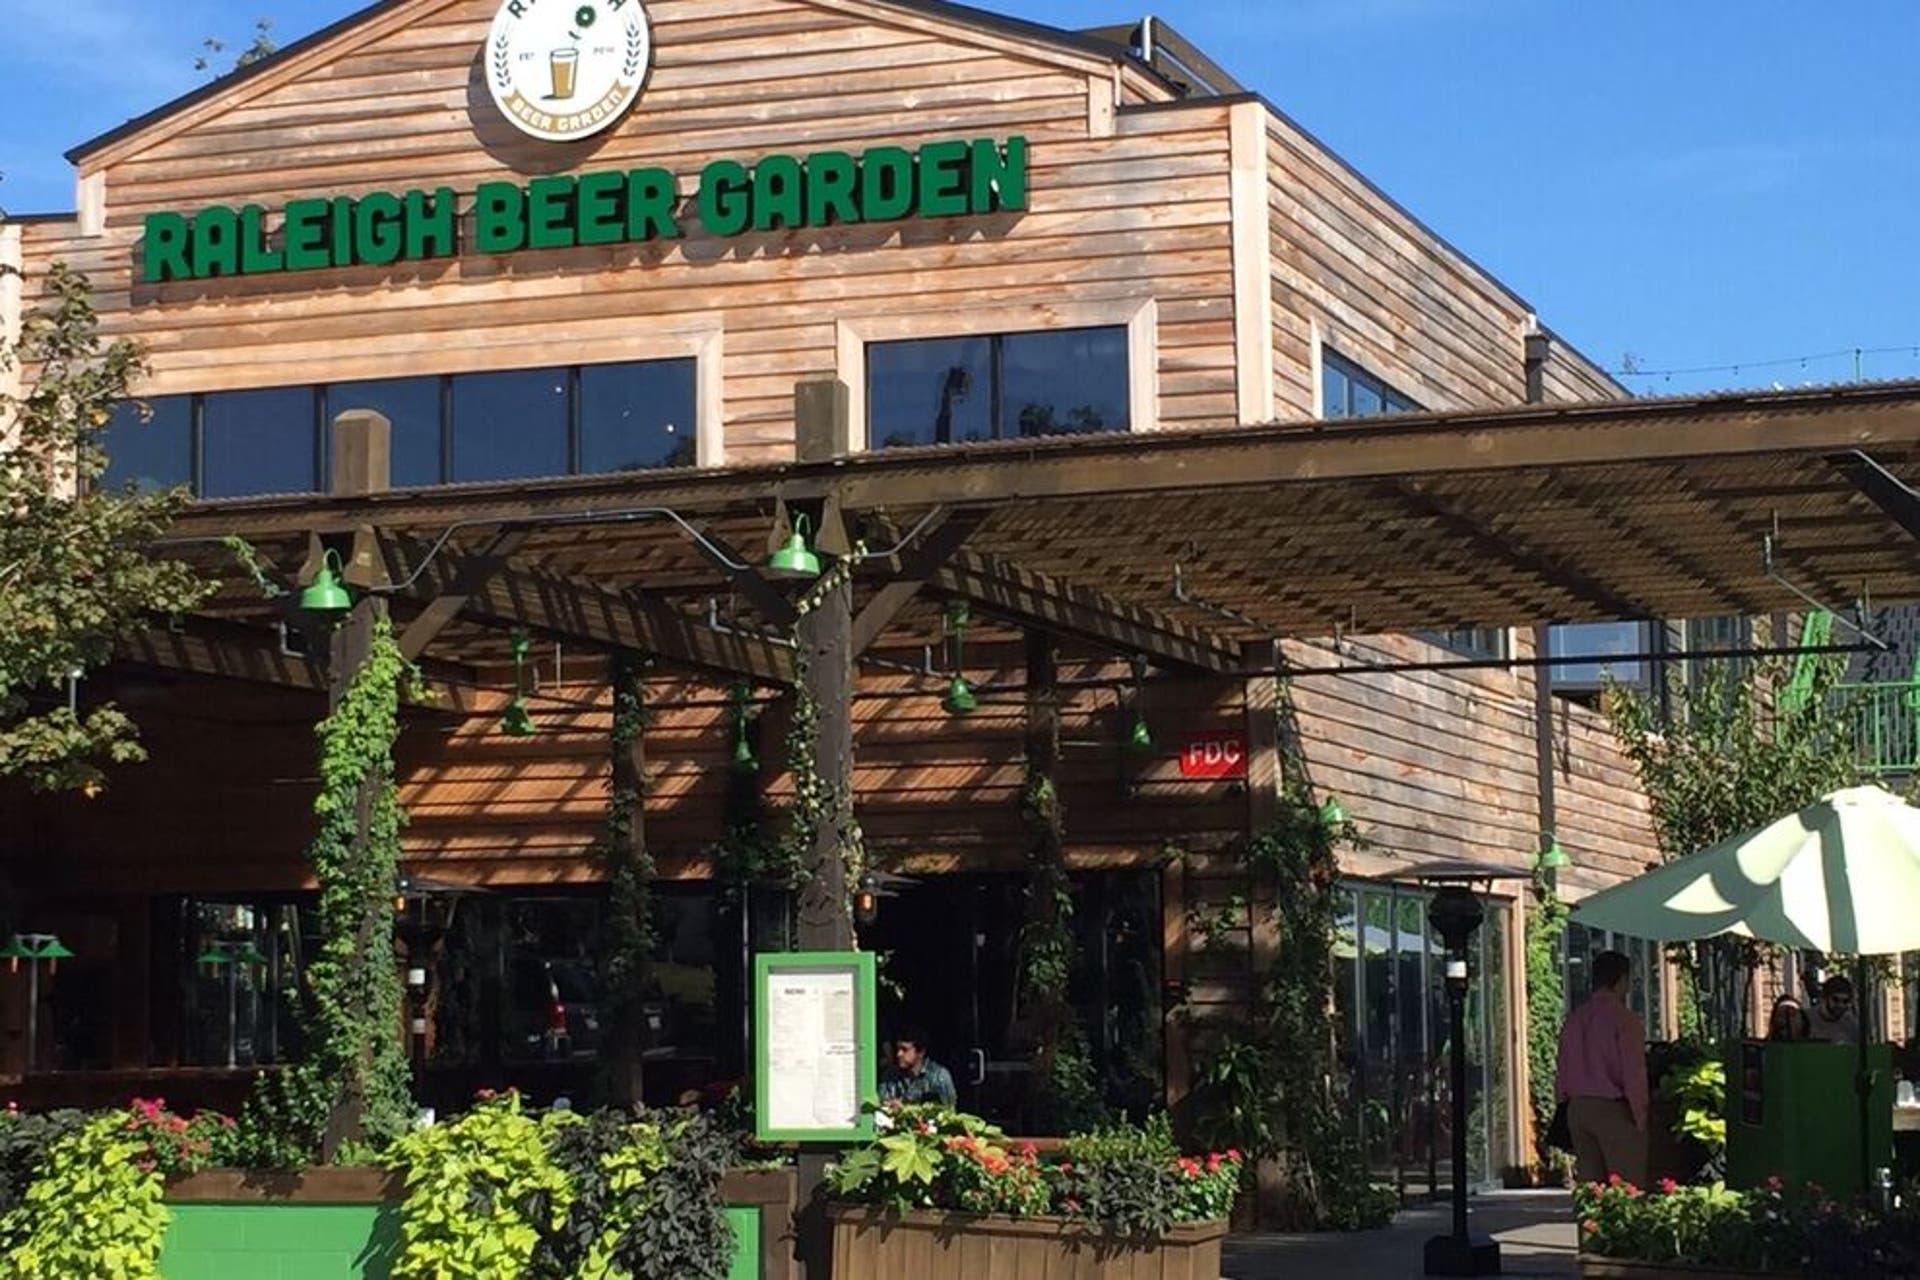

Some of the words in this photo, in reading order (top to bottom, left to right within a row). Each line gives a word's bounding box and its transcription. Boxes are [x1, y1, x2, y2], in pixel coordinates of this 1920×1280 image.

[511, 97, 550, 130] BEER
[557, 90, 623, 132] GARDEN
[143, 186, 457, 283] RALEIGH
[475, 165, 680, 254] BEER
[699, 134, 1027, 237] GARDEN
[1189, 740, 1241, 767] FDC
